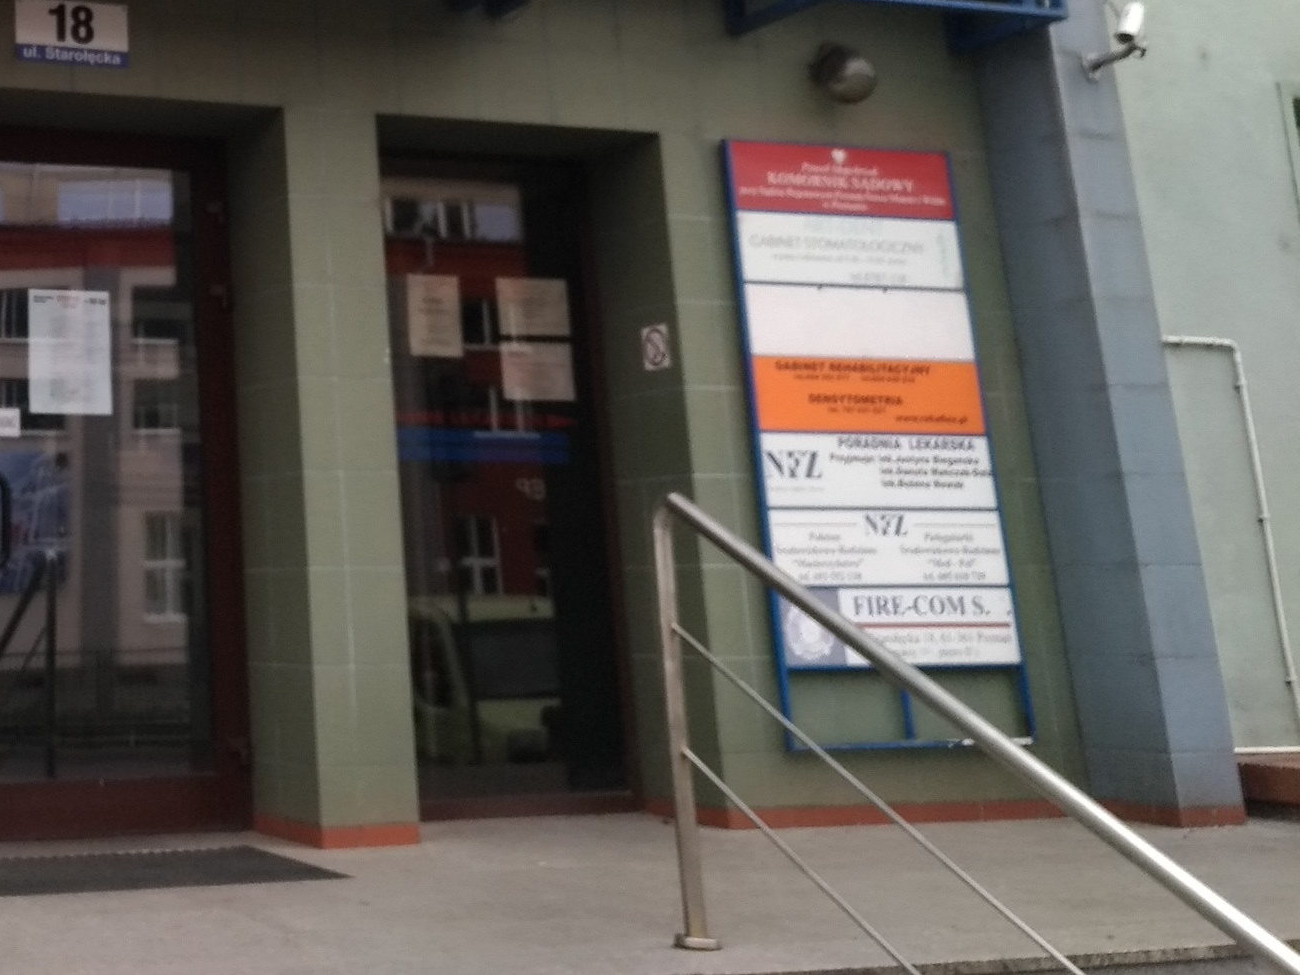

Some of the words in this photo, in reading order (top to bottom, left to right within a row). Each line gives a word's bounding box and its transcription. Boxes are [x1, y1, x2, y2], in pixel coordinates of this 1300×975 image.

[48, 4, 94, 44] 18
[22, 46, 41, 59] ul.
[852, 594, 966, 618] FIRE-COM
